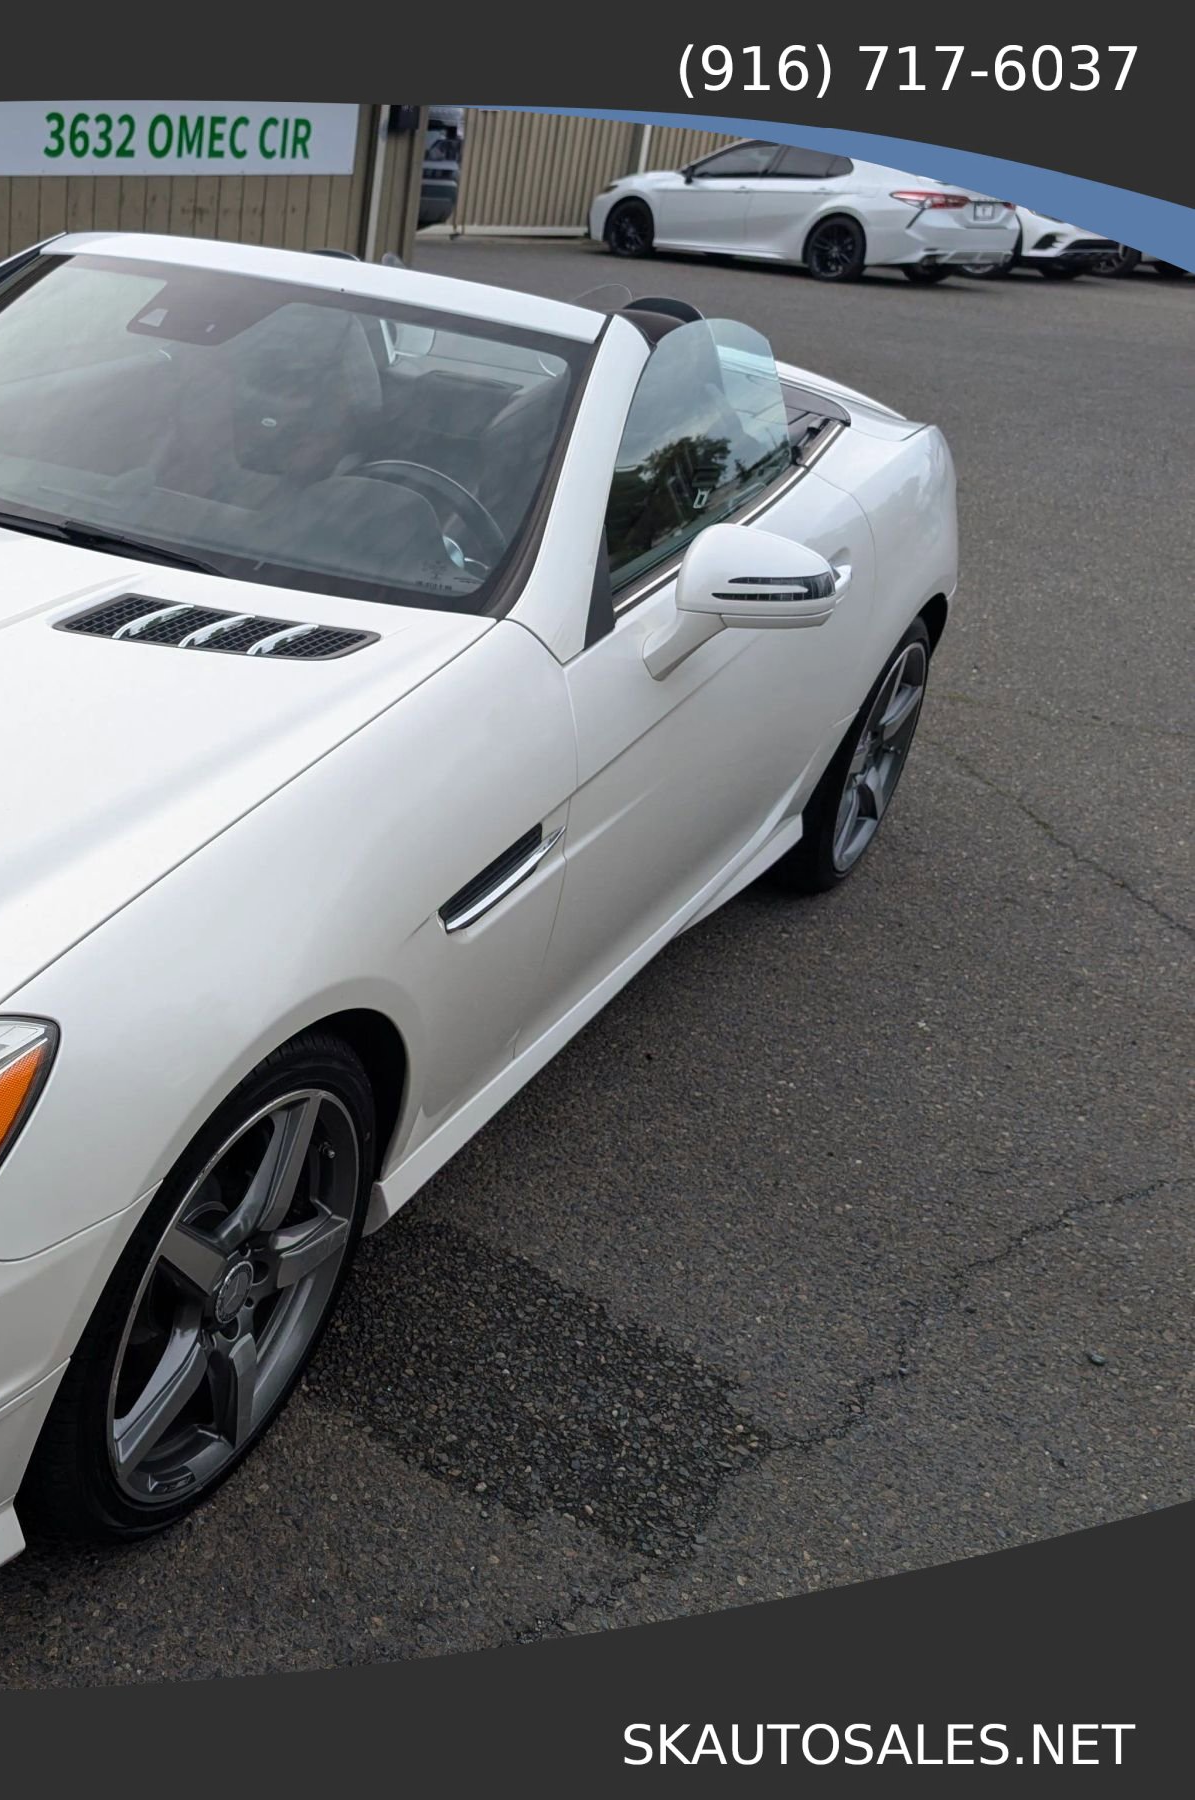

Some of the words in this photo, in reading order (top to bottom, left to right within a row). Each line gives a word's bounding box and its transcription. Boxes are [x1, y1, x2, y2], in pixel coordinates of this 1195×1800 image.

[43, 111, 136, 159] 3632
[147, 113, 250, 159] OMEC
[258, 116, 312, 159] CIR
